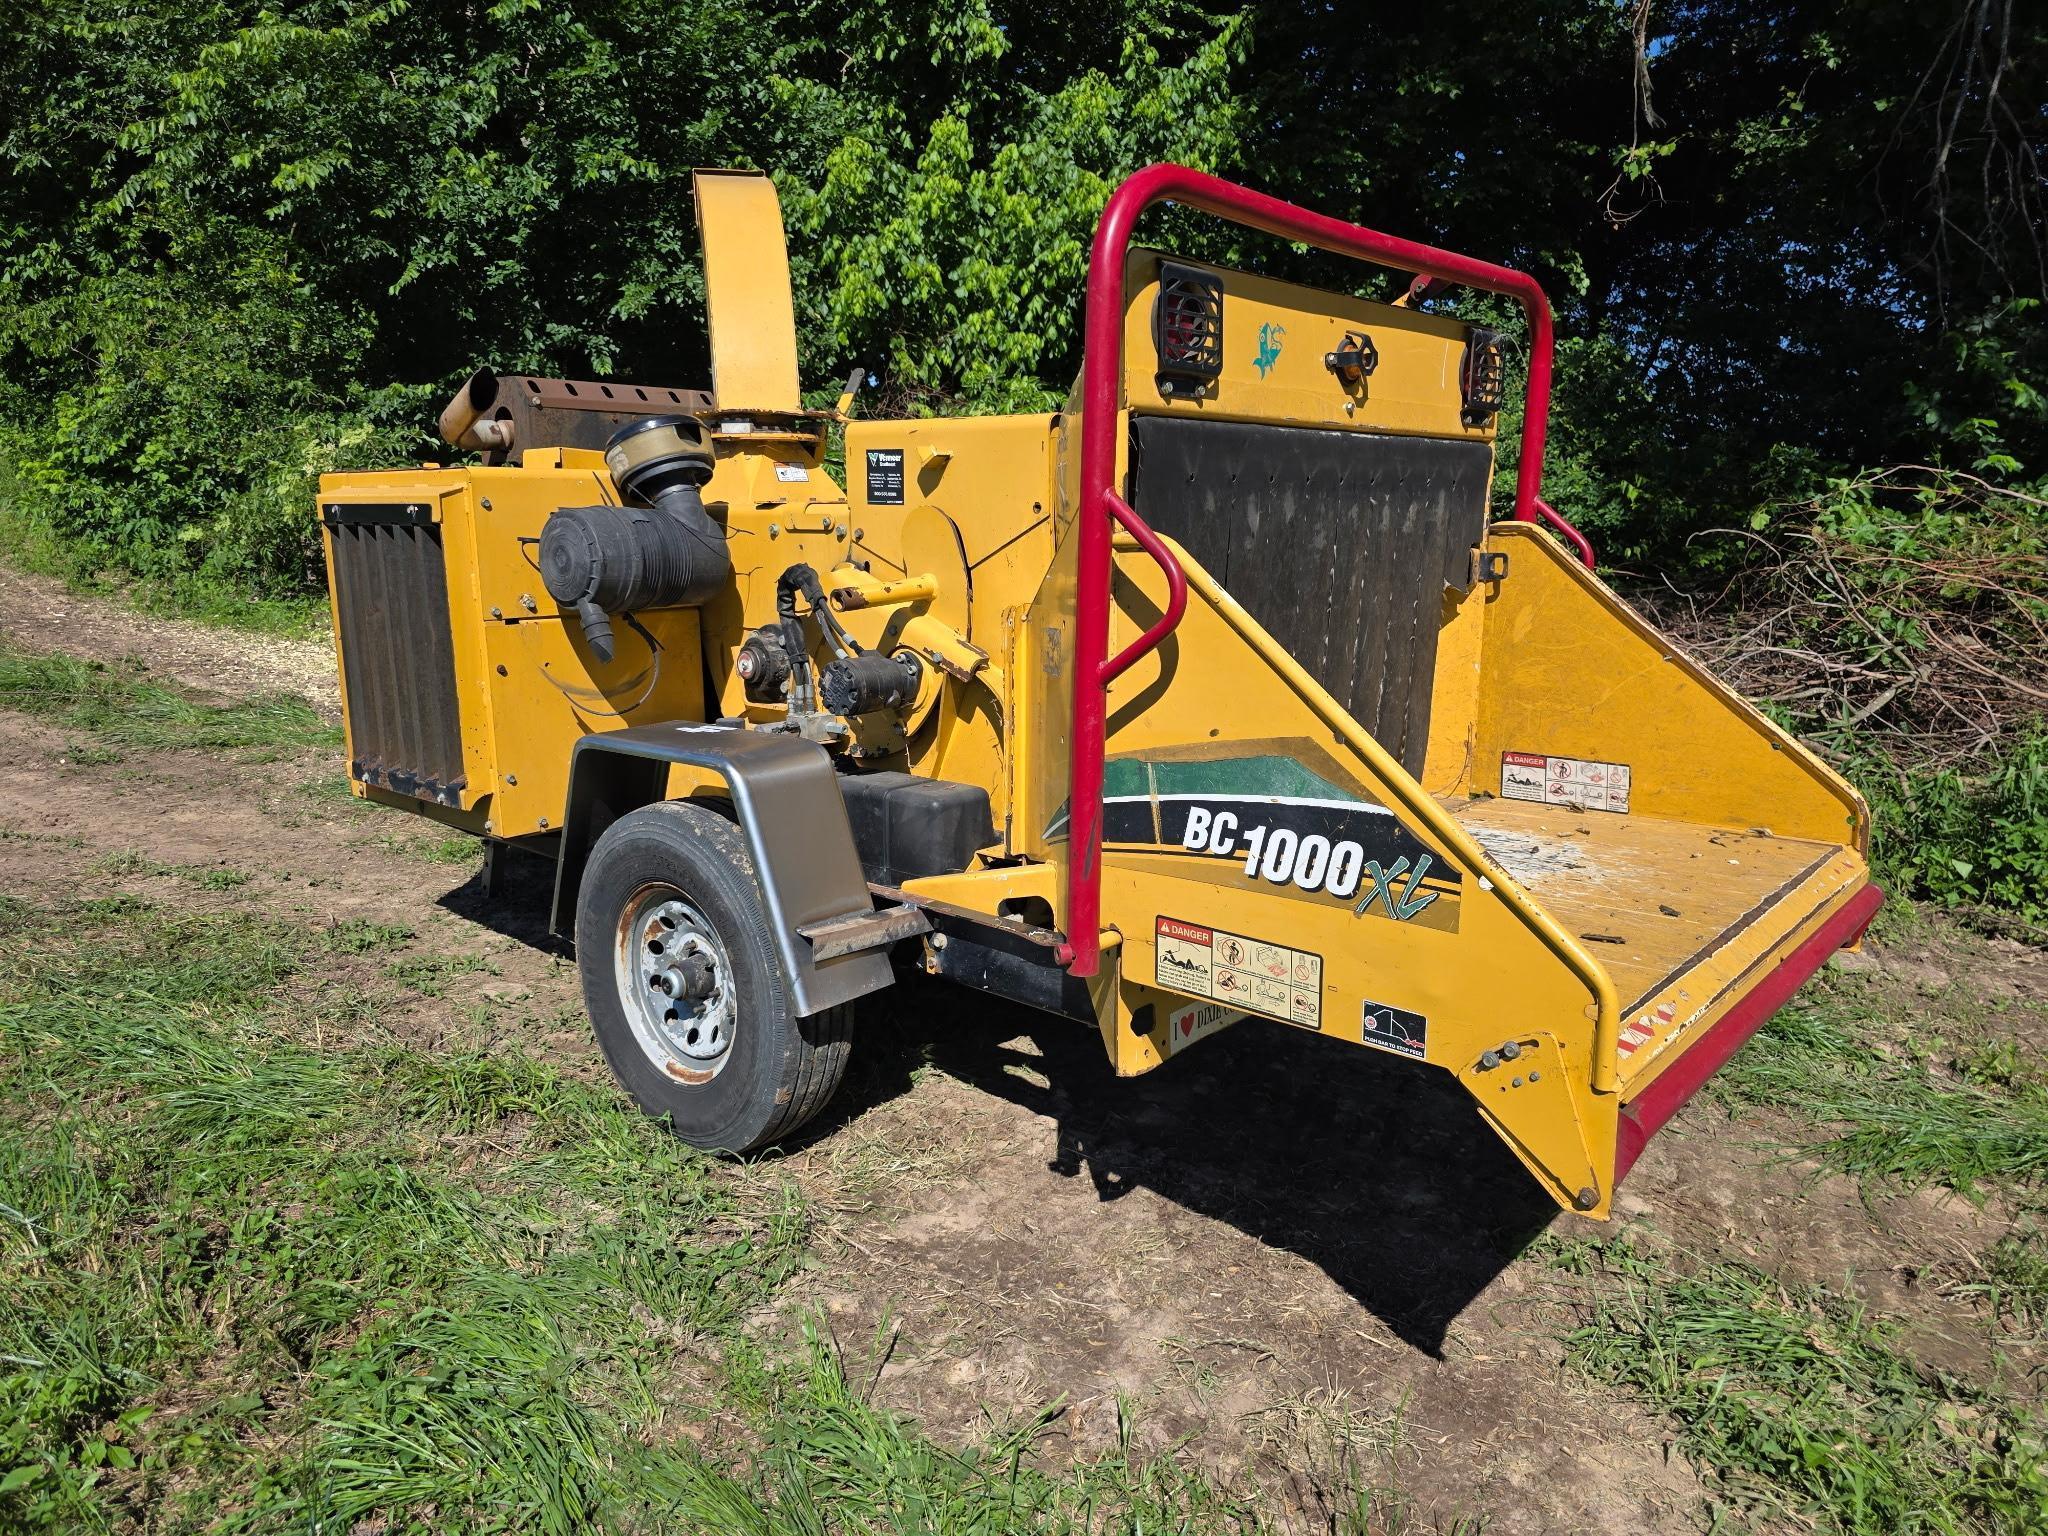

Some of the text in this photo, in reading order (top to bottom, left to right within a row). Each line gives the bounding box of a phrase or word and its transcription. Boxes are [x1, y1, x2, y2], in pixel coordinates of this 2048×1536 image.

[1514, 756, 1545, 766] DANGER
[1183, 806, 1441, 921] BC 1000 XL
[1171, 925, 1210, 942] DANGER
[1173, 1022, 1178, 1041] I
[1197, 1004, 1222, 1029] DIXIE
[1364, 1035, 1378, 1043] PUSH
[1378, 1039, 1388, 1047] BAR
[1396, 1045, 1410, 1053] STOP
[1410, 1049, 1423, 1057] FEED
